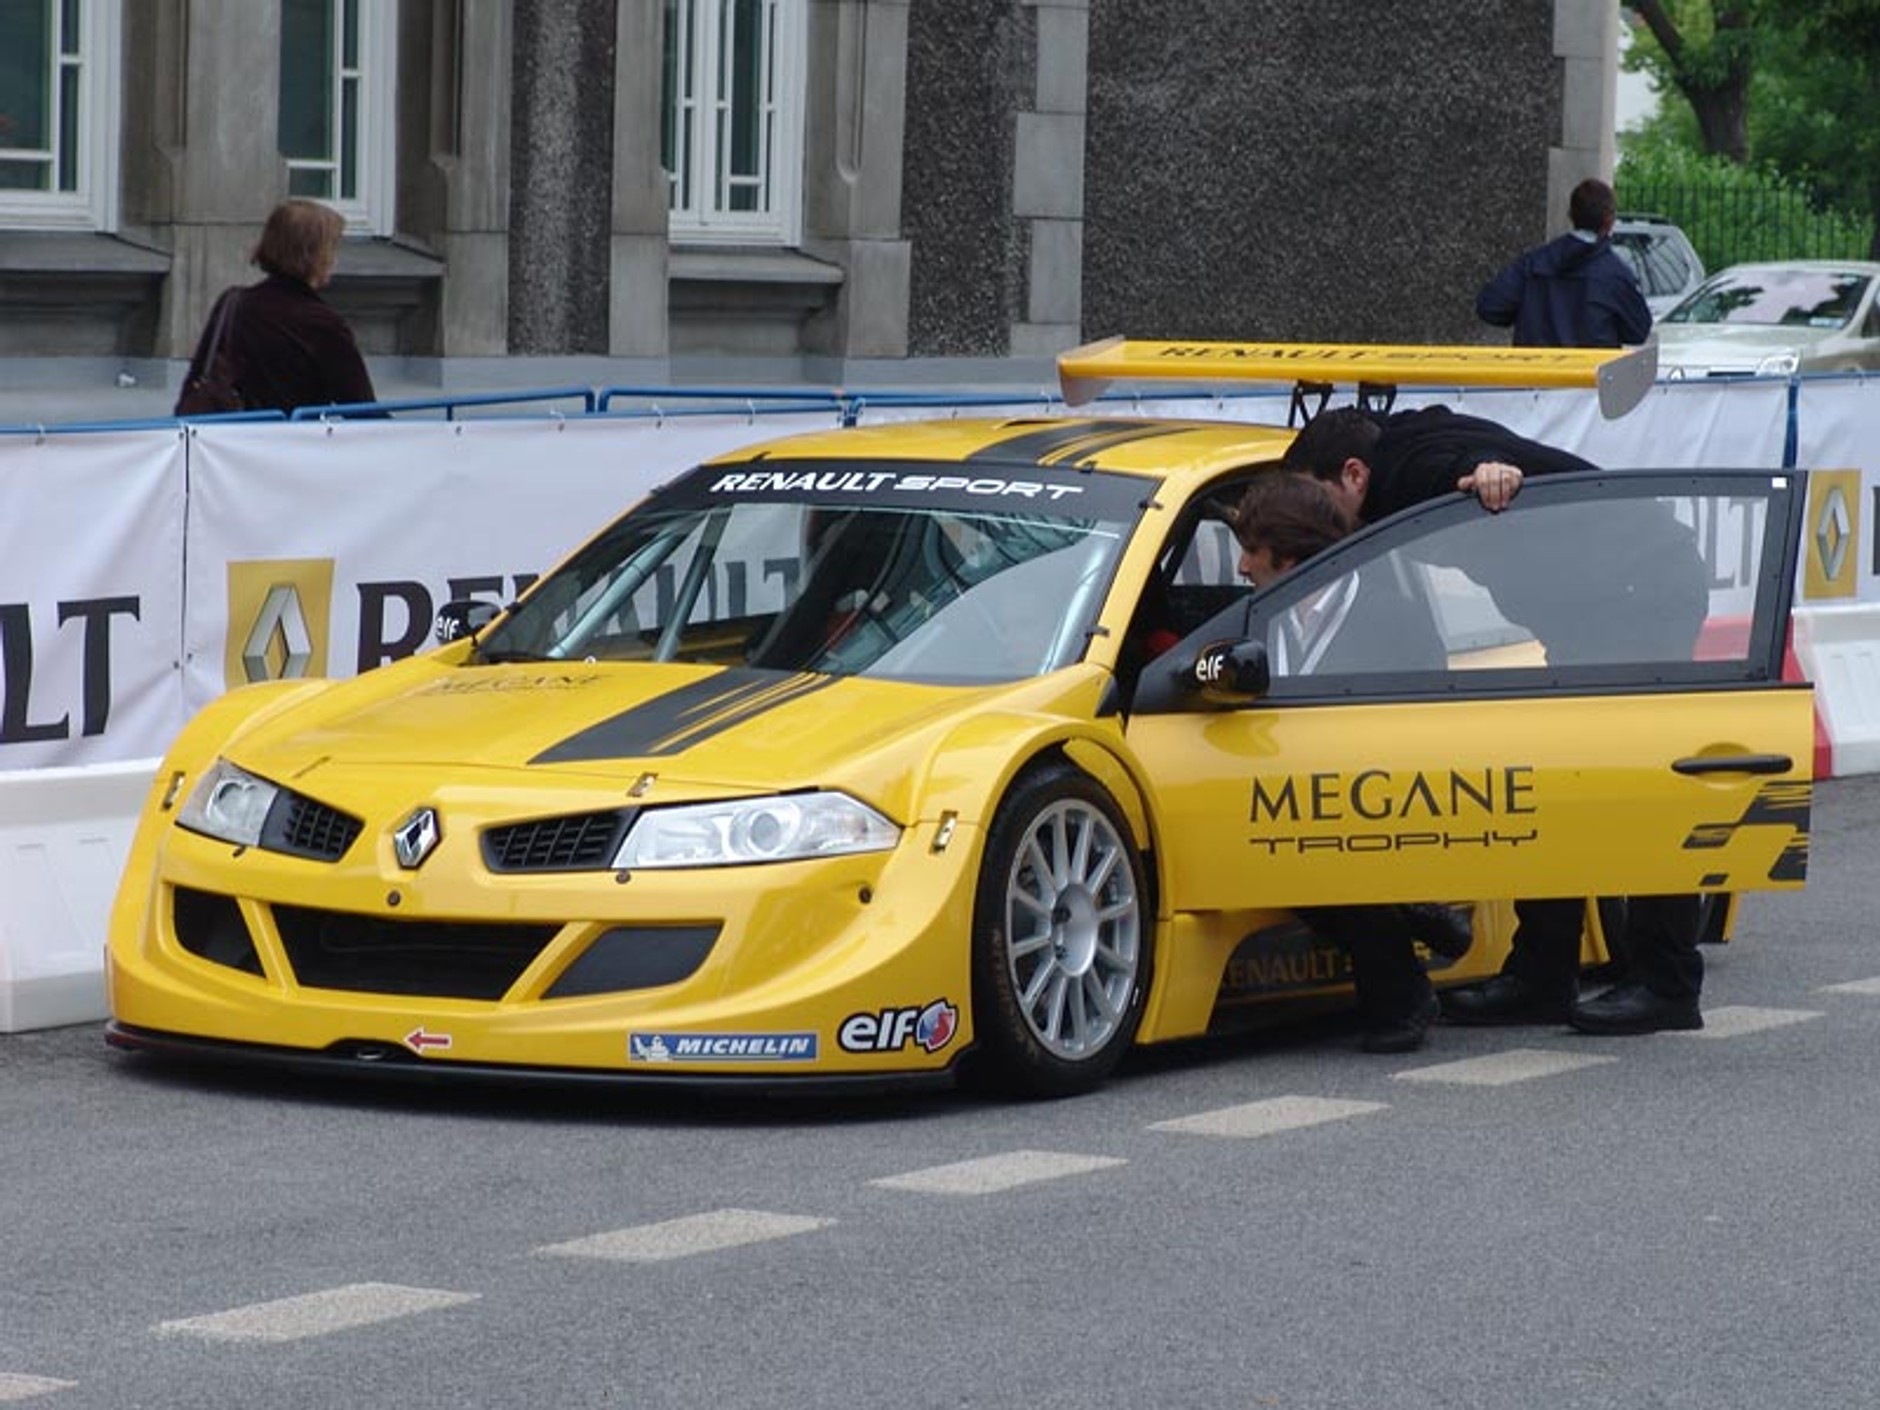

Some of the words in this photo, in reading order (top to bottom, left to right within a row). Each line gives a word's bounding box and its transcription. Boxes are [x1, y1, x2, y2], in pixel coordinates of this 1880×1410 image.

[709, 472, 896, 493] RENAULT
[893, 475, 1084, 500] SPORT
[1195, 654, 1225, 681] elf
[1249, 766, 1537, 823] MEGANE
[1249, 828, 1538, 855] TROPHY
[840, 1010, 918, 1050] elf
[675, 1037, 810, 1055] MICHELIN
